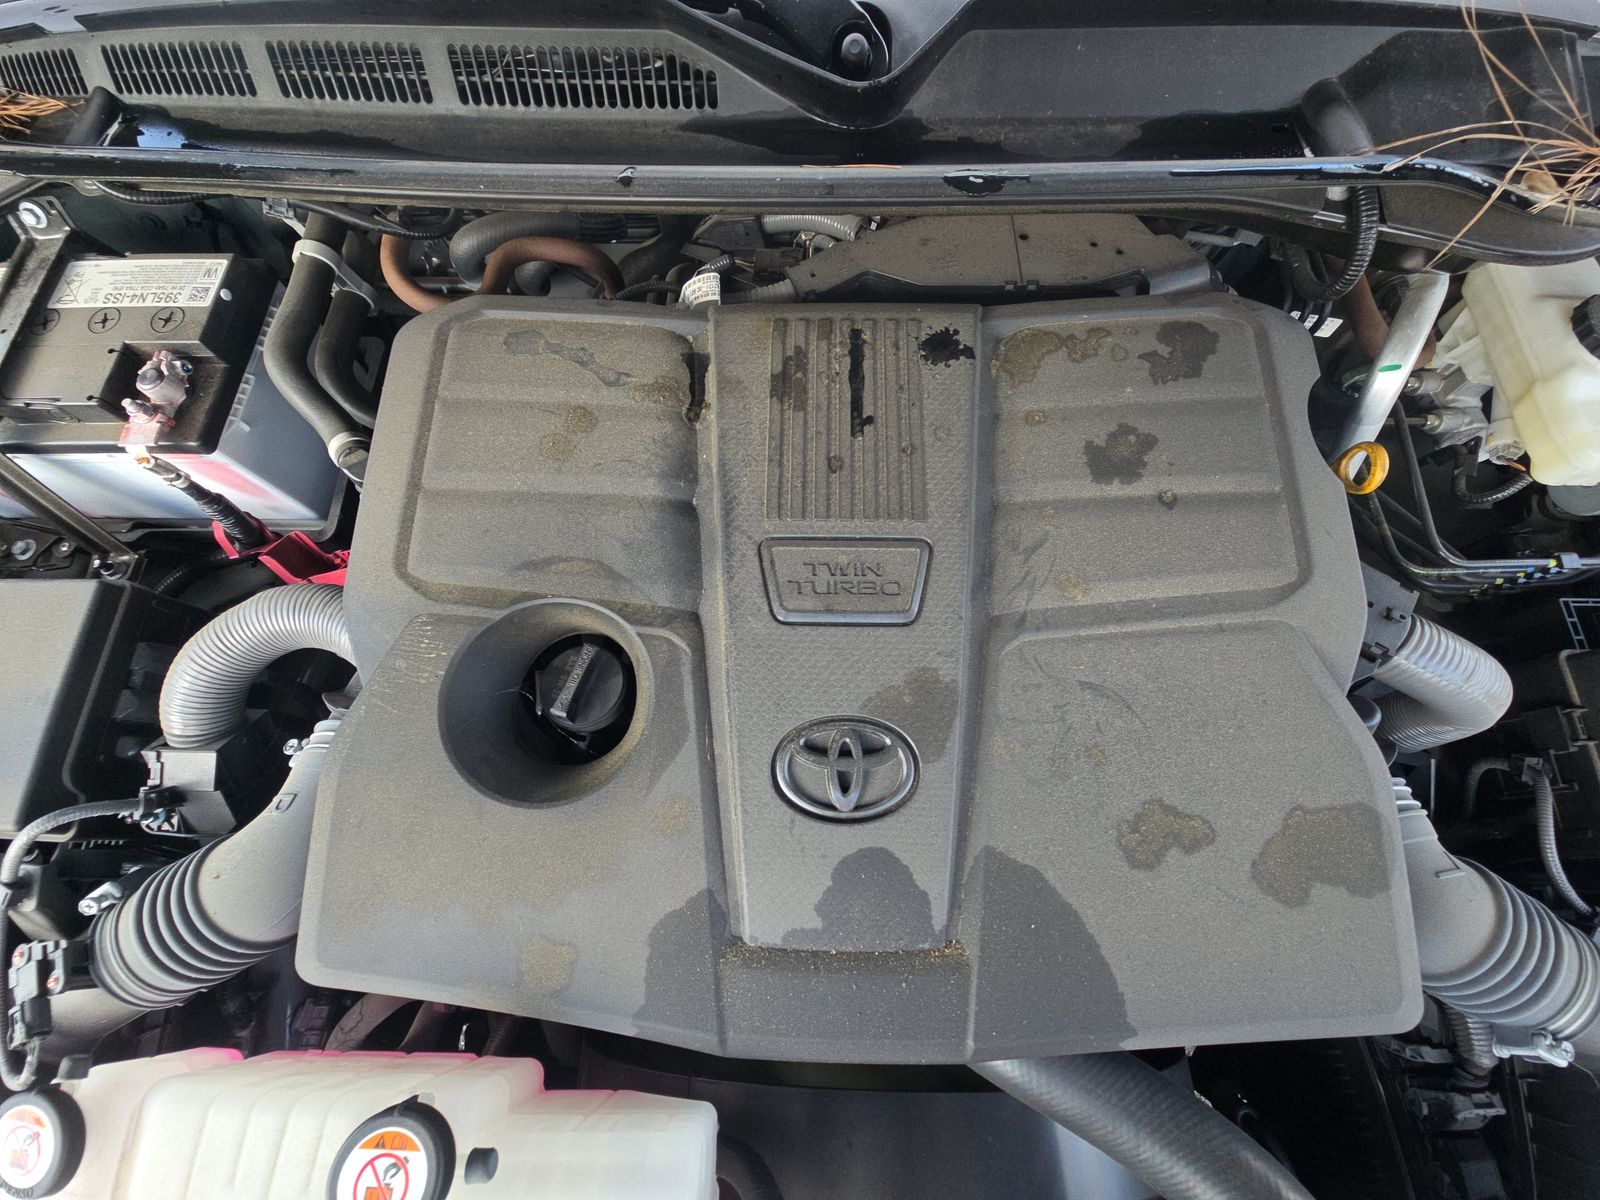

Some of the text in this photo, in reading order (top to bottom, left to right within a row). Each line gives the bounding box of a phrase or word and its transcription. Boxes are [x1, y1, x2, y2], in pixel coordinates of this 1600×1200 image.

[203, 268, 218, 278] VM
[102, 292, 182, 304] 395LN4-ISS
[803, 562, 882, 577] TWIN
[787, 579, 901, 596] TURBO
